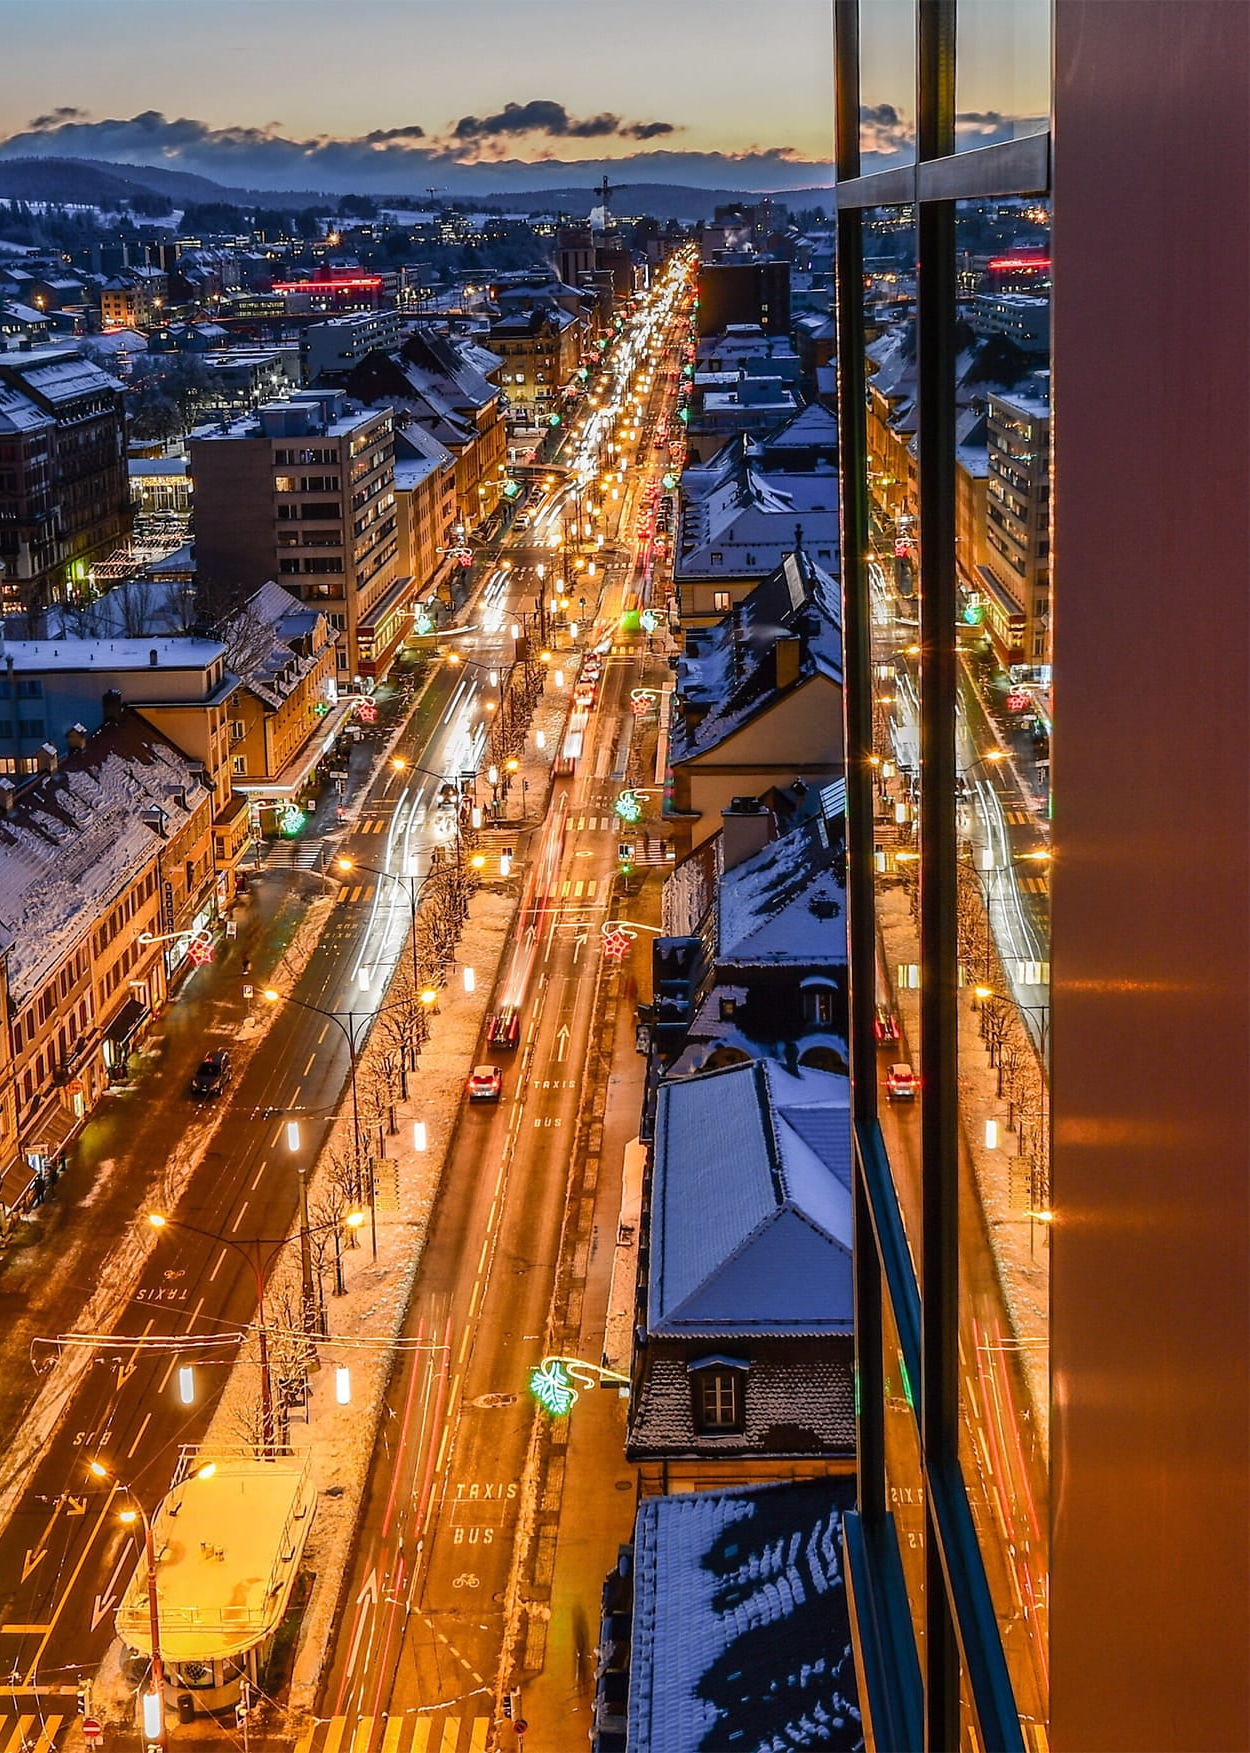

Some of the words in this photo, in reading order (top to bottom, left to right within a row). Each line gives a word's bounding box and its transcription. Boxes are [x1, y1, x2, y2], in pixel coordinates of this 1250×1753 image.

[533, 1080, 576, 1089] TAXIS
[533, 1117, 561, 1128] BUS
[136, 1287, 188, 1300] TAXIS
[456, 1483, 518, 1499] TAXIS
[453, 1527, 494, 1545] BUS
